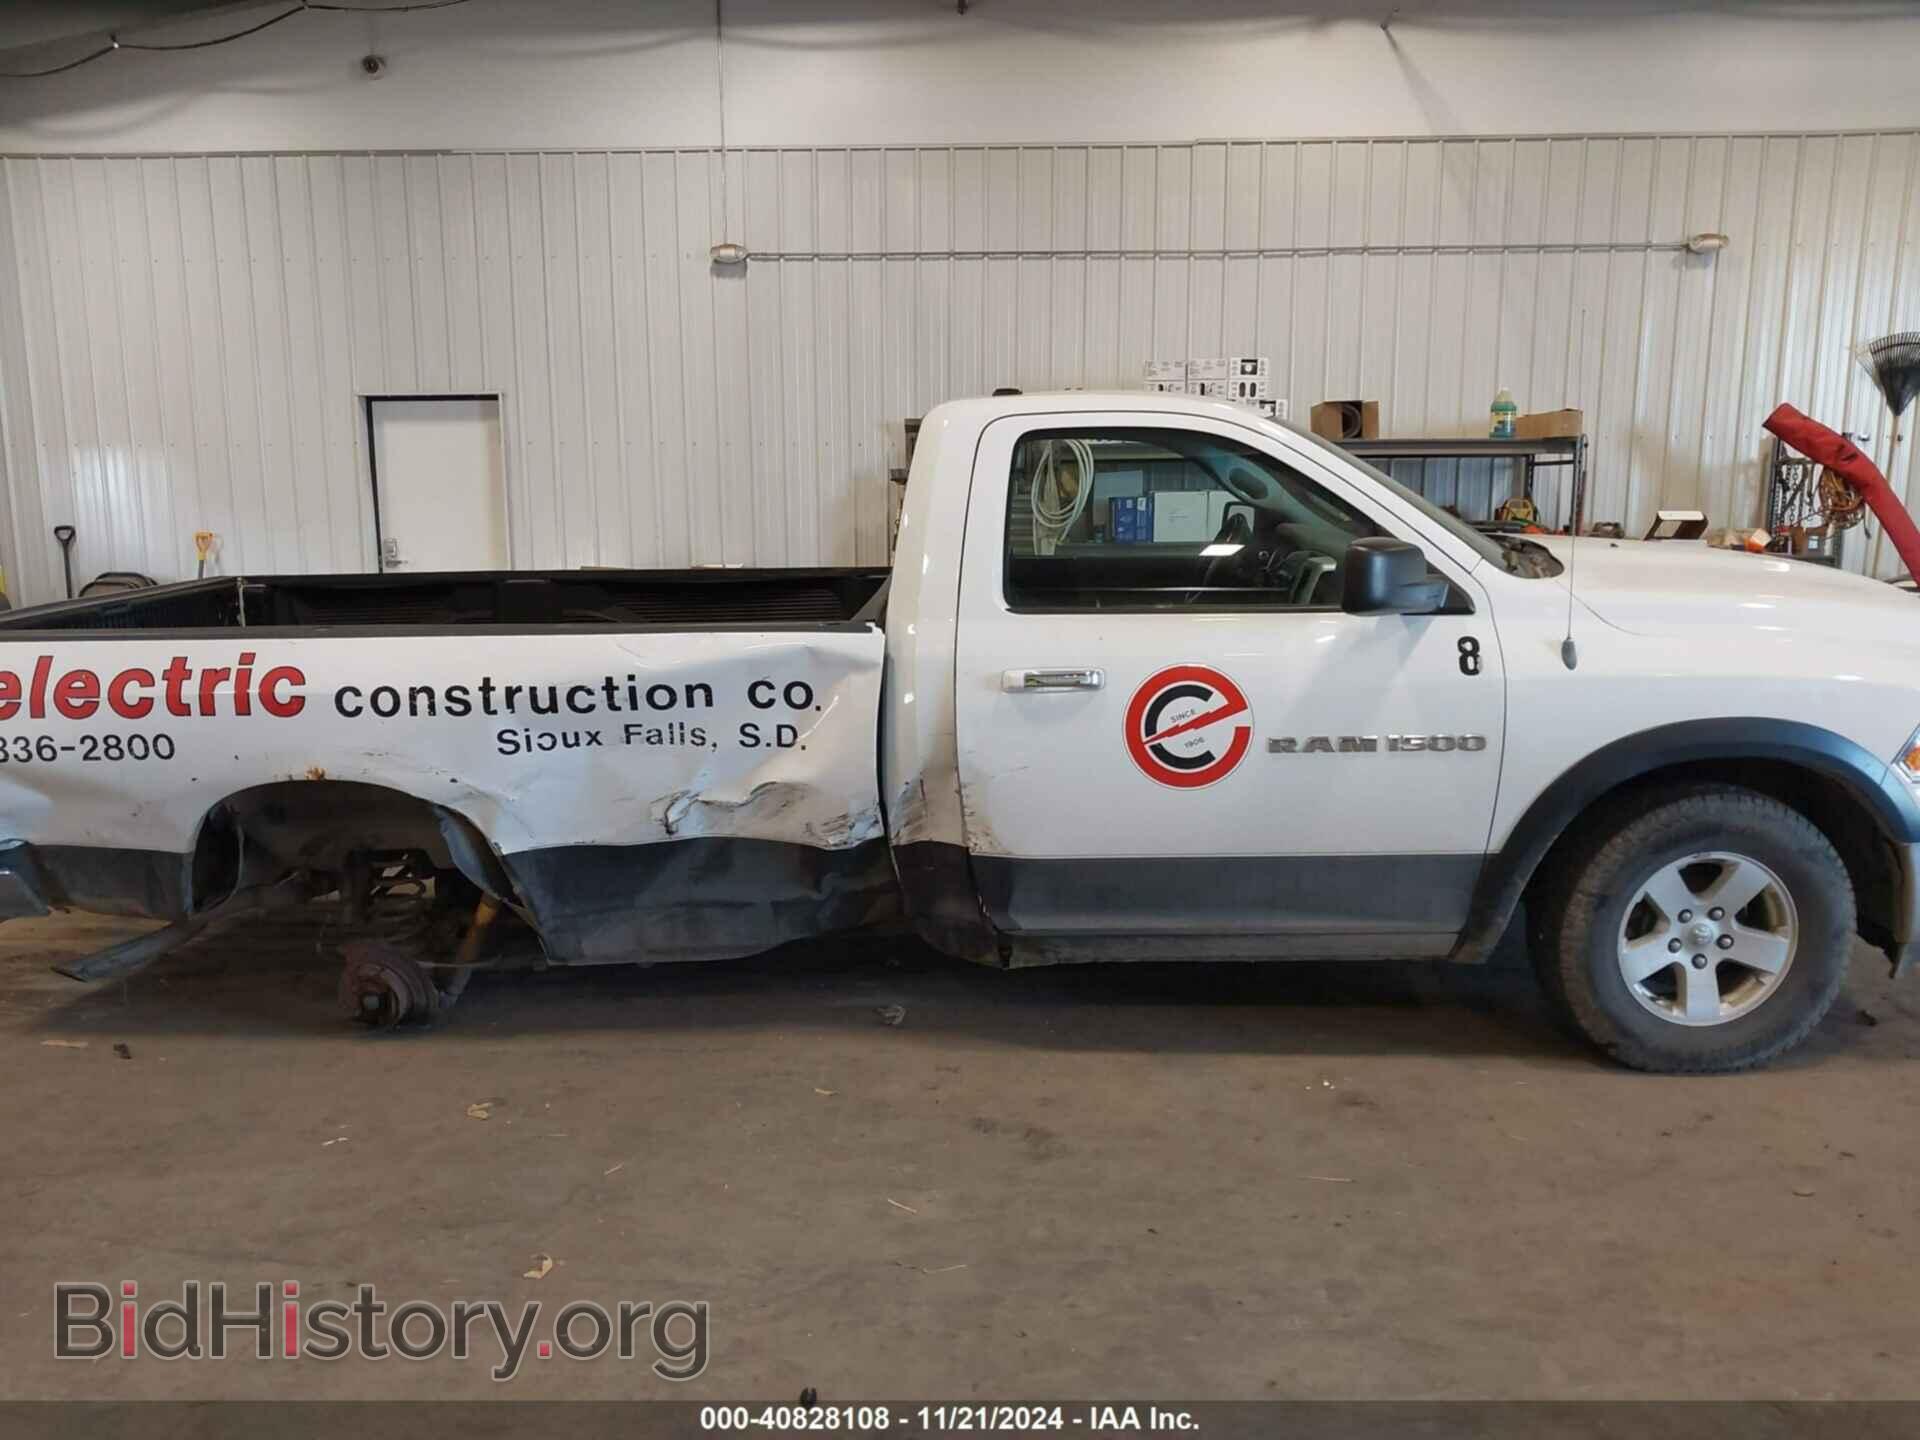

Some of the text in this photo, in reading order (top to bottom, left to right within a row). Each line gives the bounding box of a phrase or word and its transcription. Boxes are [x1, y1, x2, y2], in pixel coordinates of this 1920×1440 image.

[1457, 636, 1480, 676] 8
[334, 673, 714, 718] construction
[747, 679, 822, 712] co.
[496, 721, 806, 756] Sioux Falls, S.D.
[1268, 734, 1487, 753] RAM 1500
